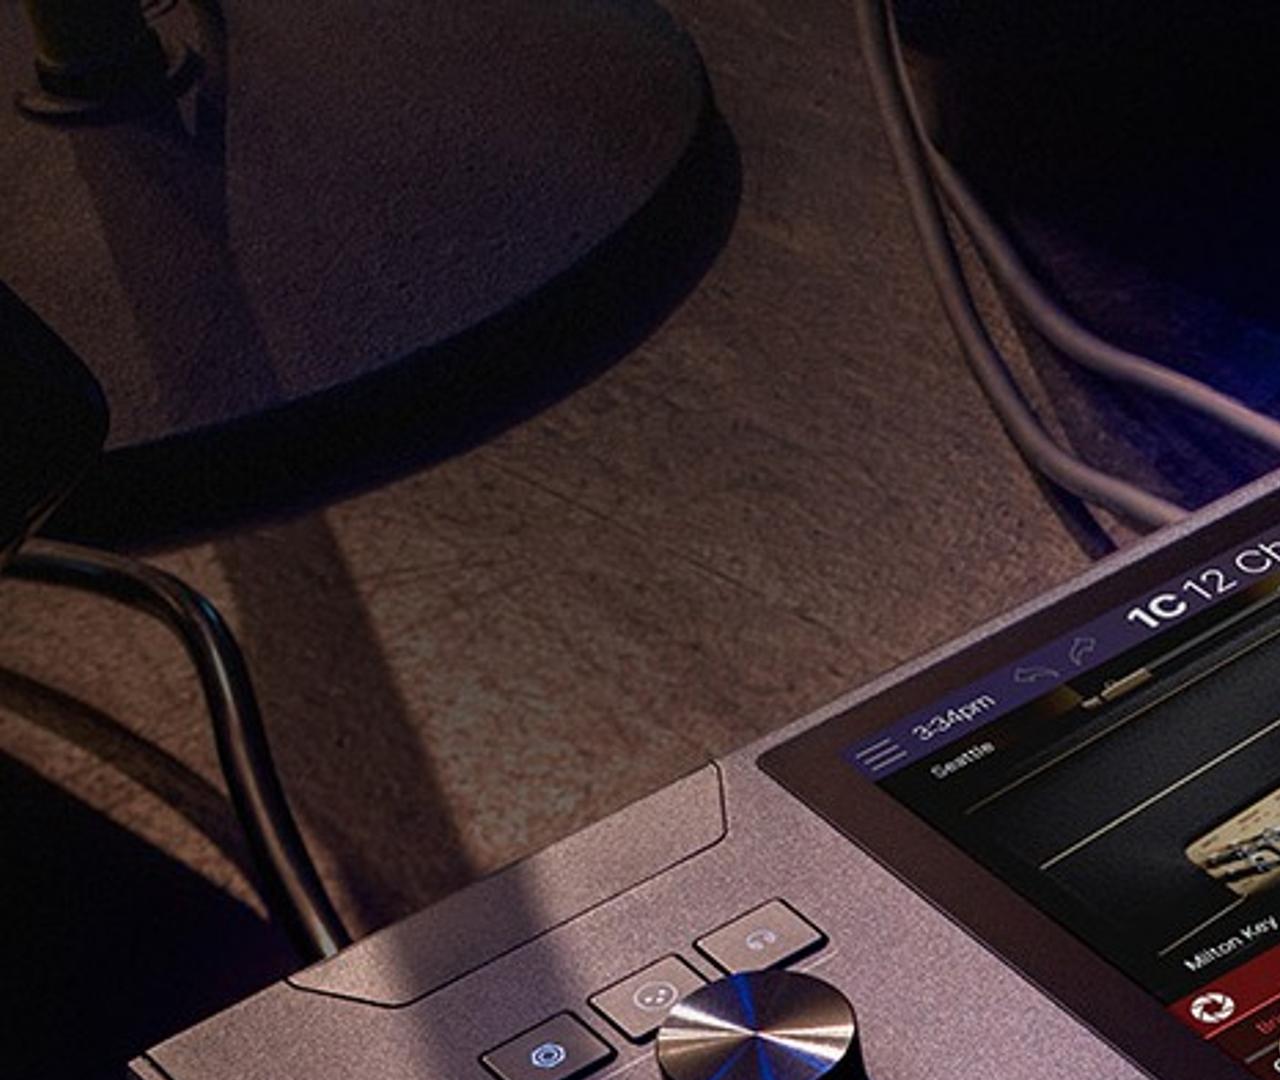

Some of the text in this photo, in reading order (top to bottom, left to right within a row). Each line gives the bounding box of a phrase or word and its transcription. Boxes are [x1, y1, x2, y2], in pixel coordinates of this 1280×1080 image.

[1127, 592, 1187, 628] 1C
[1183, 569, 1238, 600] 12
[912, 695, 996, 740] 3:34pm
[930, 742, 995, 779] Seattle
[1184, 915, 1278, 971] Milton Key
